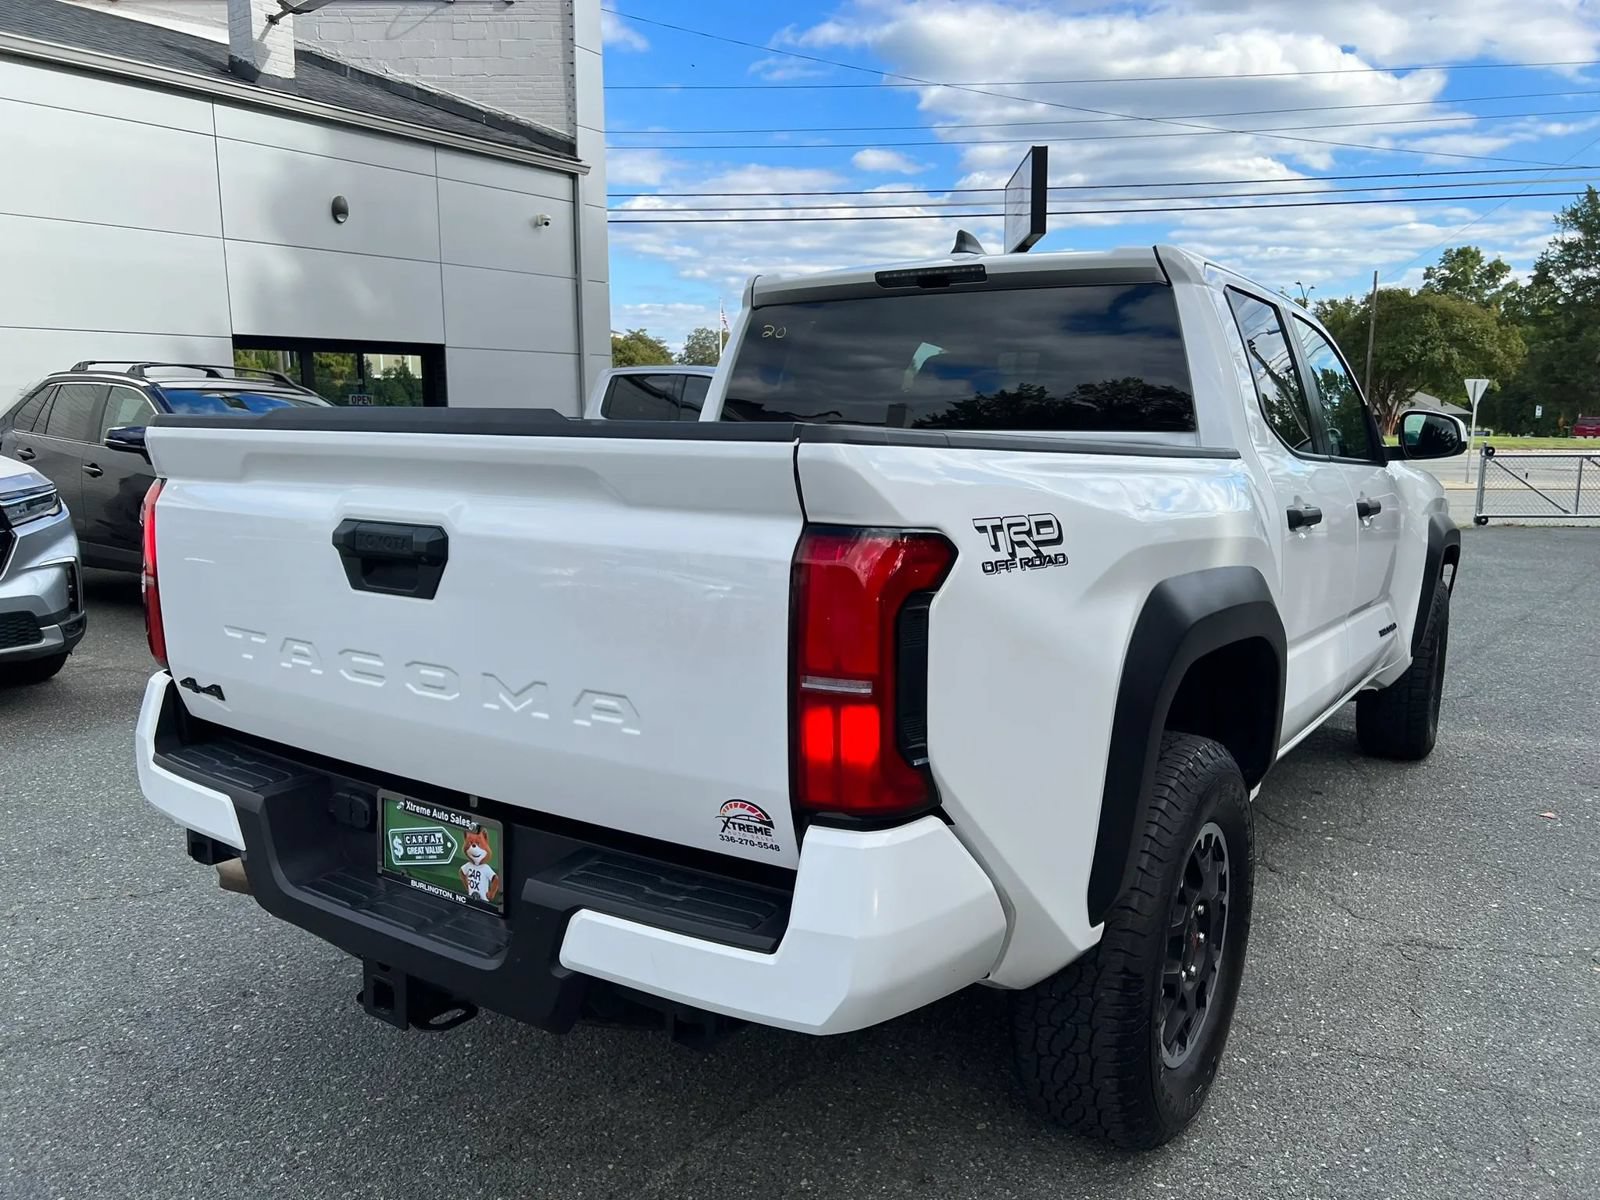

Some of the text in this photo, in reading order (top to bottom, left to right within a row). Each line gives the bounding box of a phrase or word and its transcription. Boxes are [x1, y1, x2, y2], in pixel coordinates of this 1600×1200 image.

[762, 324, 787, 339] 20
[351, 395, 373, 406] OPEN
[356, 533, 411, 553] TOYOTA
[972, 512, 1064, 559] TRD
[981, 553, 1069, 575] OFF ROAD
[223, 624, 641, 736] TACOMA
[405, 800, 472, 828] Xtreme Auto Sales
[720, 816, 773, 837] XTREME
[405, 833, 444, 845] CARFAX
[718, 834, 781, 852] 336-270-5548
[406, 845, 445, 855] GREAT VALUE
[468, 868, 481, 881] CAR
[410, 879, 467, 904] BURLINGTON, NC
